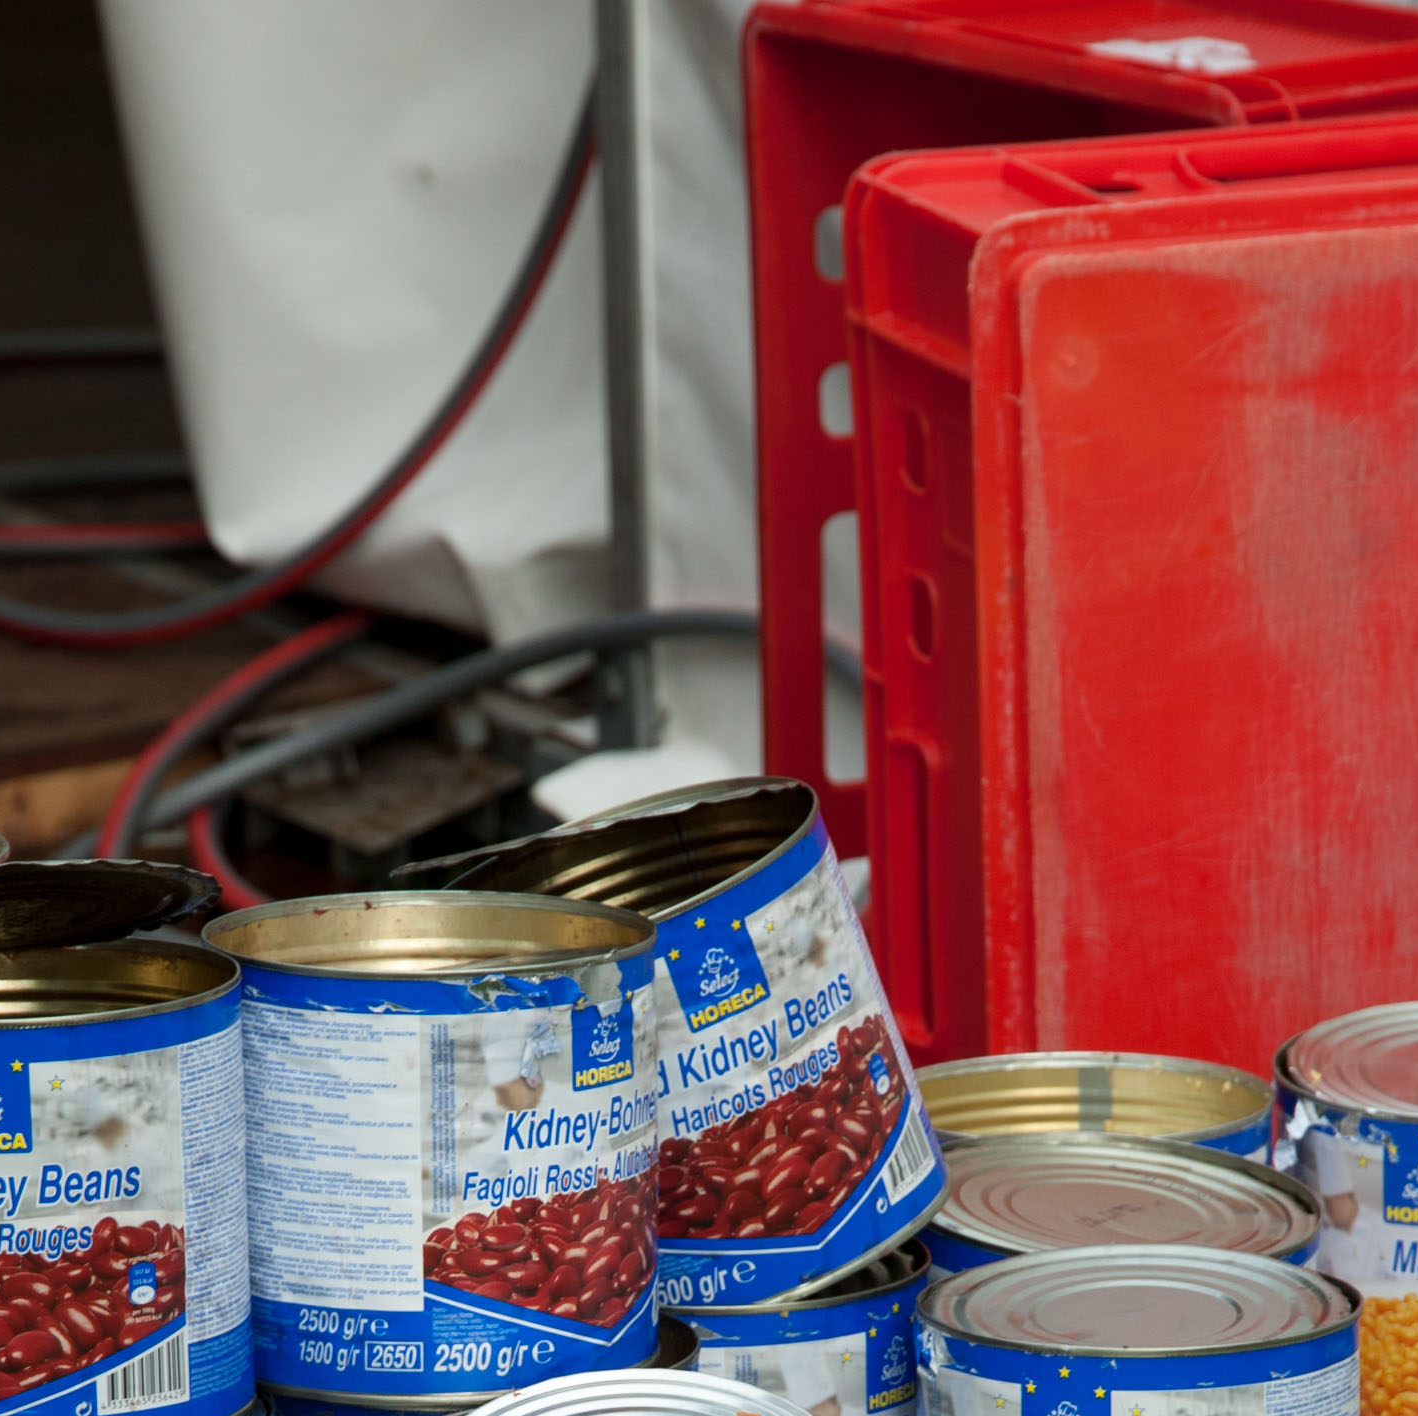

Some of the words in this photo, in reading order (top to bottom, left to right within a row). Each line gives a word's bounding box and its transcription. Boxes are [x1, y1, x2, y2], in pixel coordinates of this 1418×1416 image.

[690, 983, 767, 1030] HORECA
[678, 1019, 778, 1089] Kidney
[784, 973, 852, 1039] Beans
[575, 1060, 632, 1088] HORECA
[671, 1083, 766, 1138] Haricots
[768, 1041, 839, 1098] Rouges
[39, 1163, 141, 1205] Beans
[463, 1167, 539, 1207] Fagioli
[545, 1157, 599, 1194] Rossi
[298, 1308, 339, 1334] 2500
[299, 1340, 333, 1364] 1500
[371, 1345, 418, 1369] 2650
[433, 1342, 492, 1373] 2500
